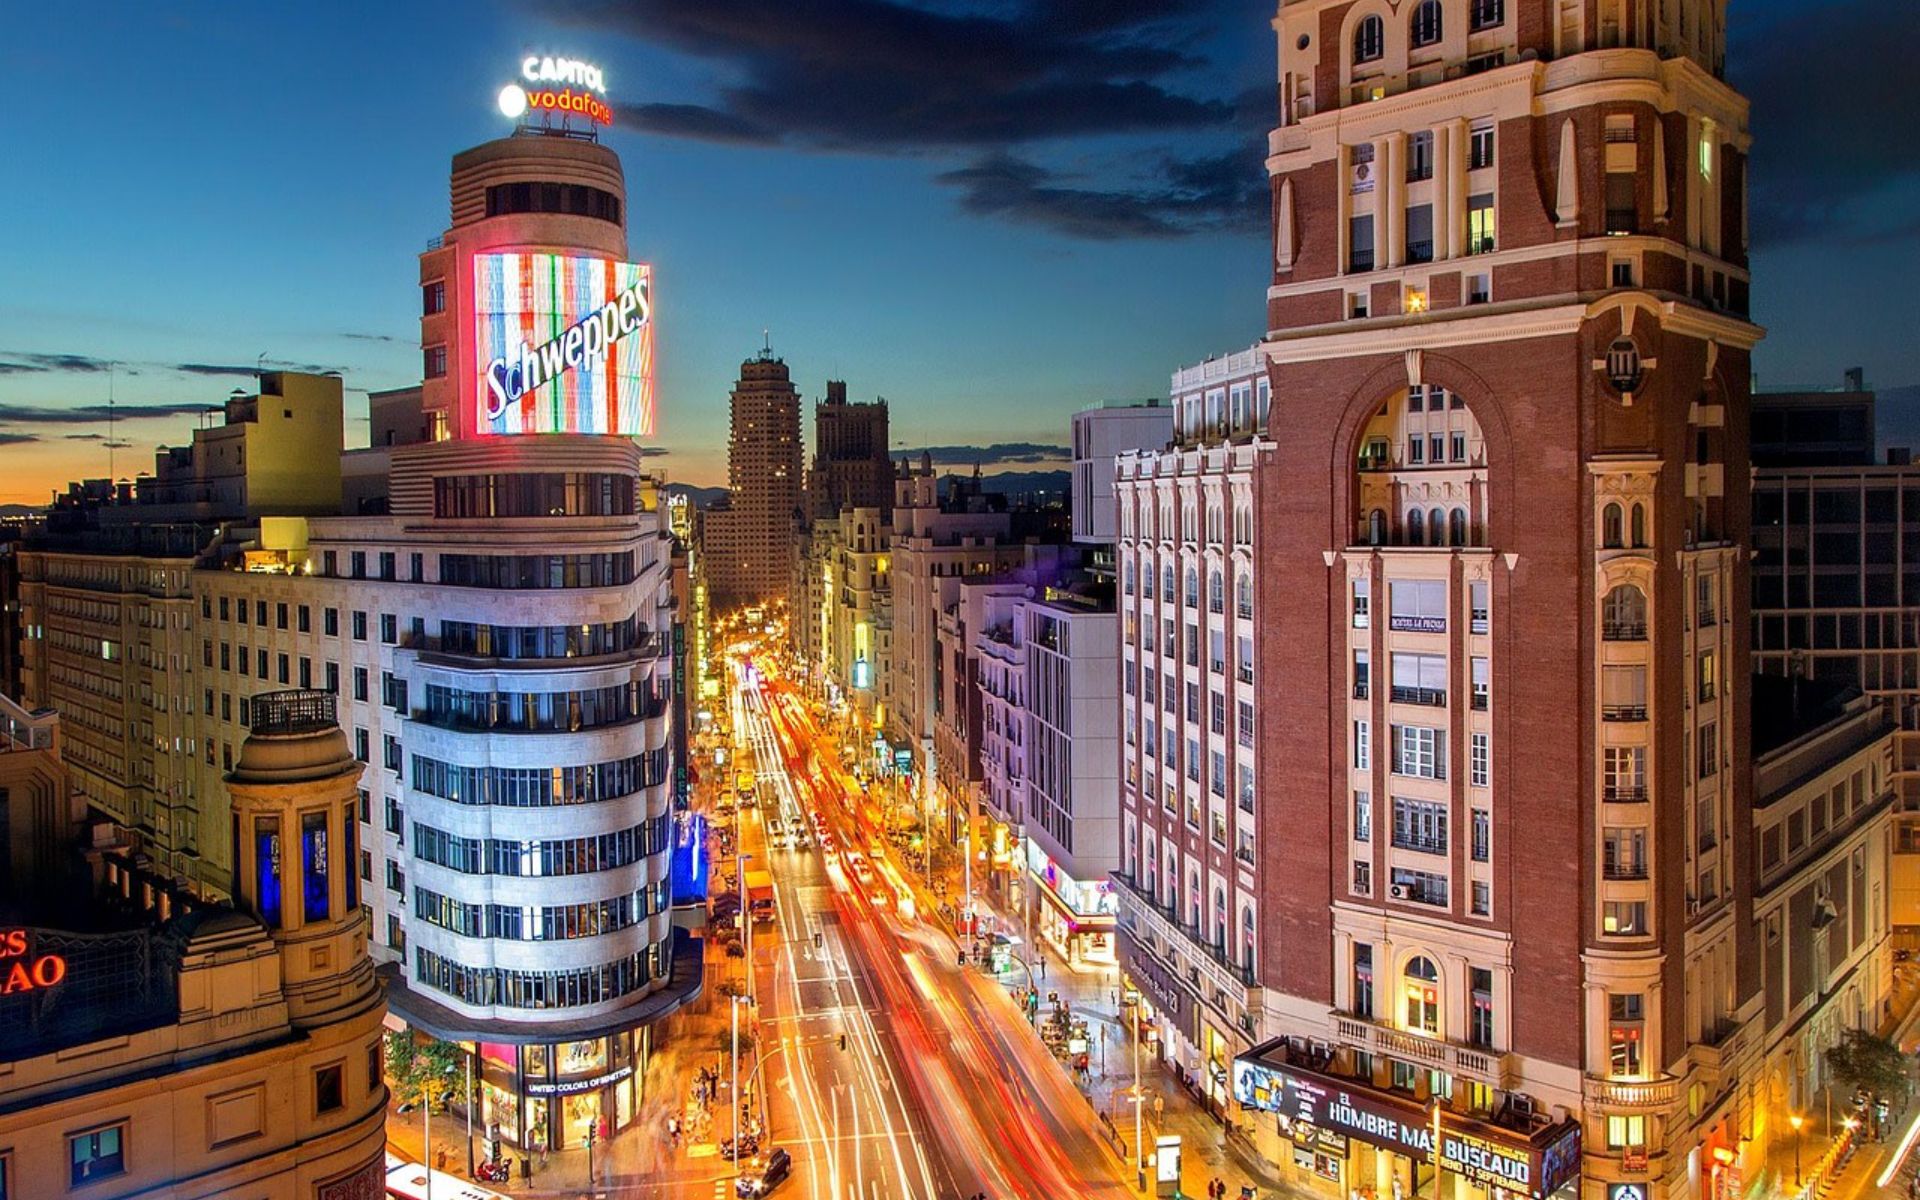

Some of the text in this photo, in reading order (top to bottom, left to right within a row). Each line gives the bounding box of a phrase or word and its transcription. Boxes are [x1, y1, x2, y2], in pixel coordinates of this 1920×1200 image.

[523, 56, 606, 93] CAPITOL
[527, 89, 613, 125] vodafone
[487, 278, 649, 420] Schweppes
[675, 627, 686, 807] HOTEL REX
[528, 1084, 556, 1093] UNITED
[557, 1080, 589, 1092] COLORS
[589, 1078, 600, 1088] OF
[1339, 1092, 1351, 1107] EL
[1329, 1101, 1397, 1141] HOMBRE
[1445, 1138, 1530, 1184] BUSCADO
[1464, 1163, 1475, 1177] 12
